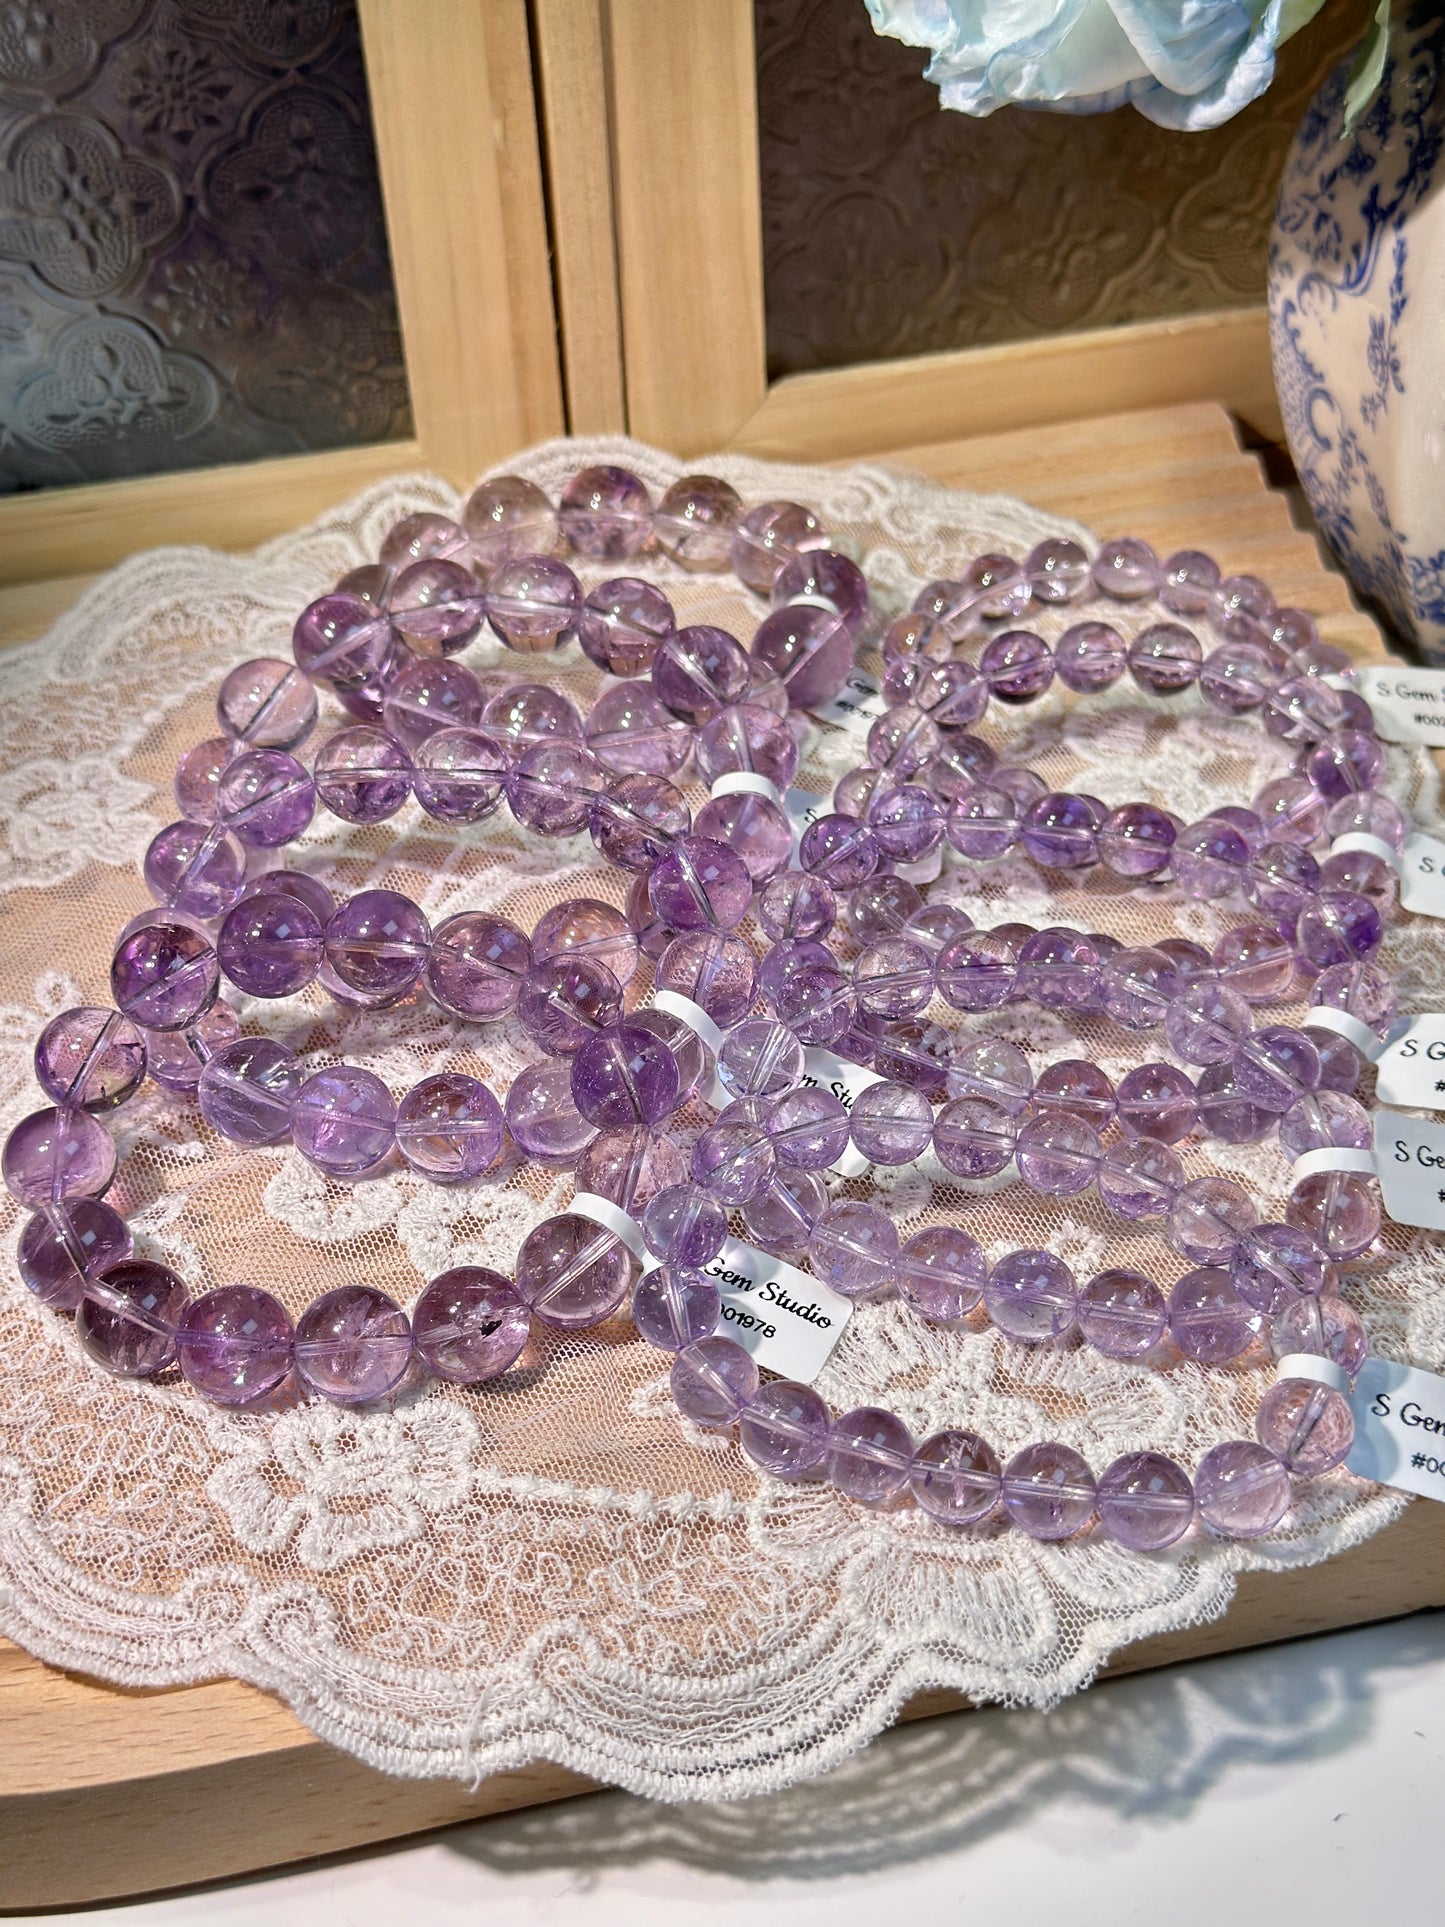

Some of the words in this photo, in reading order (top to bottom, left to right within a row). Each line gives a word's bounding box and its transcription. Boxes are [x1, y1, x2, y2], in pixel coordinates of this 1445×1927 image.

[1376, 681, 1391, 697] S
[1394, 683, 1437, 702] Gem
[1418, 856, 1434, 873] S
[1400, 1039, 1418, 1057] S
[1395, 1140, 1410, 1162] S
[703, 1256, 756, 1292] Gem
[758, 1281, 834, 1329] Studio
[1371, 1393, 1391, 1417] S
